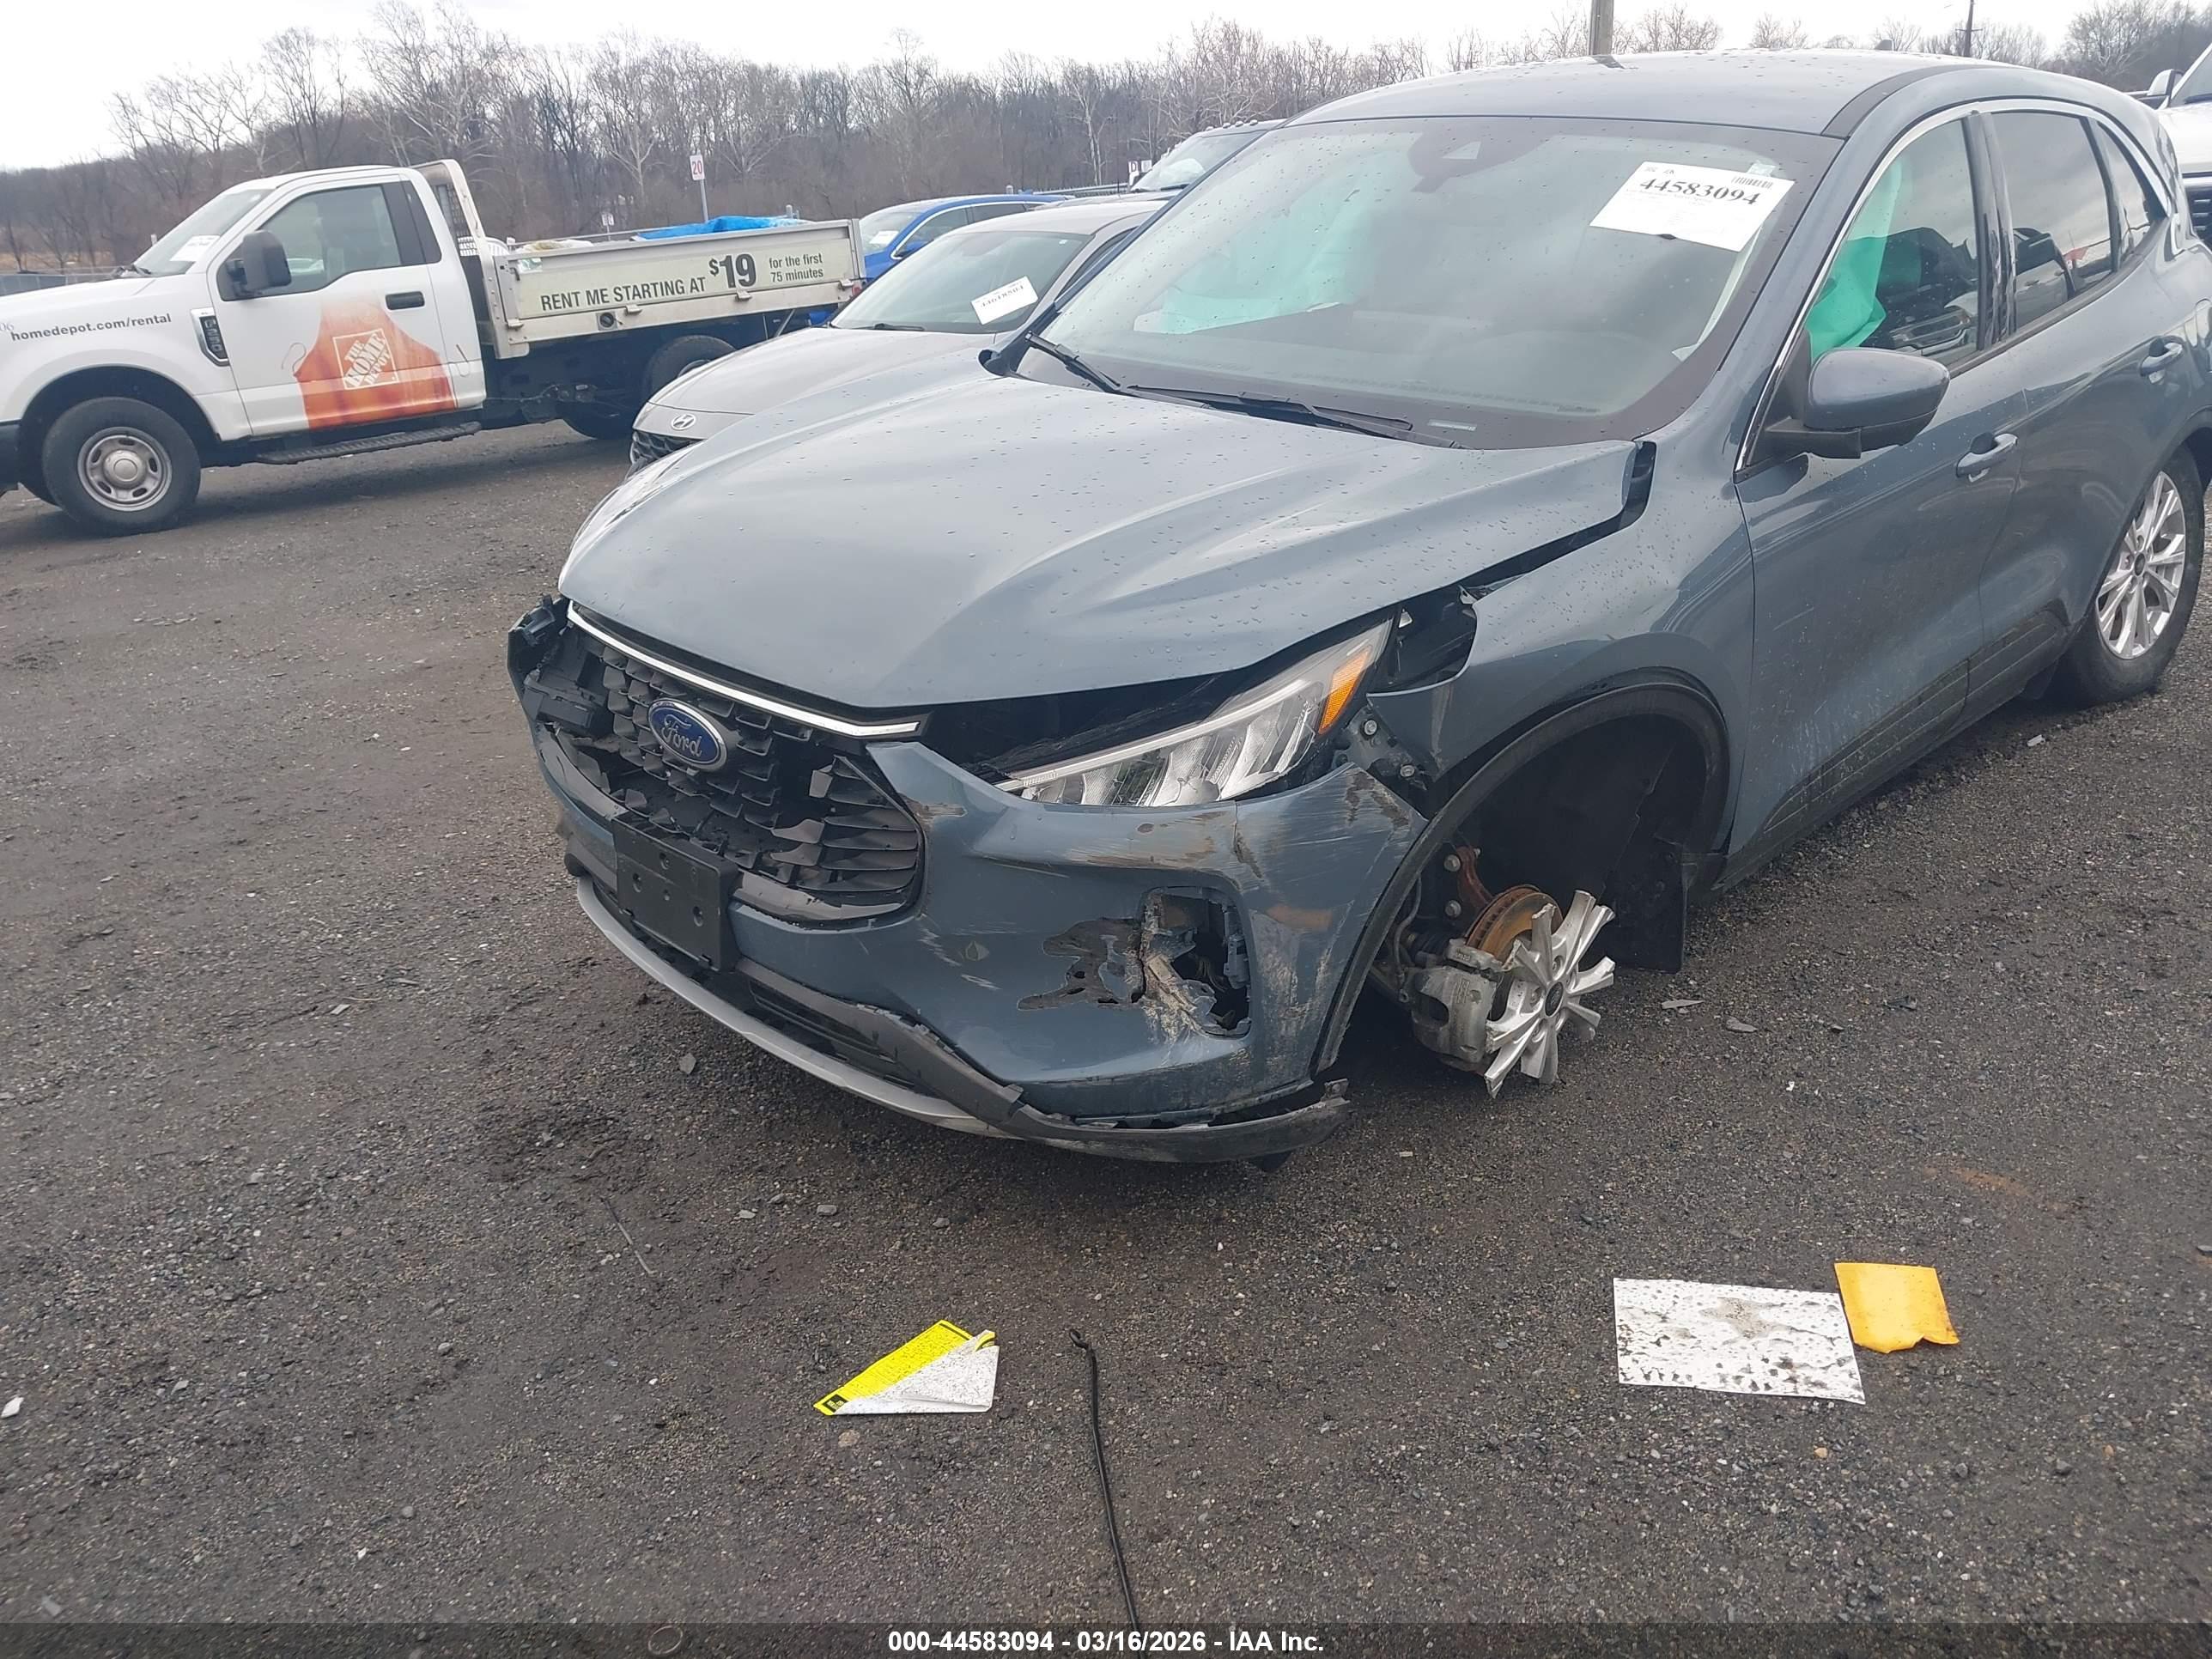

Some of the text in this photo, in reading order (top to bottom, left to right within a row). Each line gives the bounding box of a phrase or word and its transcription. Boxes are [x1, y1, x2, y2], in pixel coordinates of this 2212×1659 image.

[691, 161, 702, 175] 20
[1640, 178, 1760, 205] 44583094
[769, 252, 823, 269] for the first
[540, 253, 757, 312] RENT ME STARTING AT $19
[770, 268, 824, 283] 75 minutes
[10, 313, 172, 342] homedepot.com/rental
[343, 333, 386, 386] HOME
[344, 339, 365, 362] THE
[363, 348, 392, 386] DEPOT
[661, 714, 703, 757] Ford
